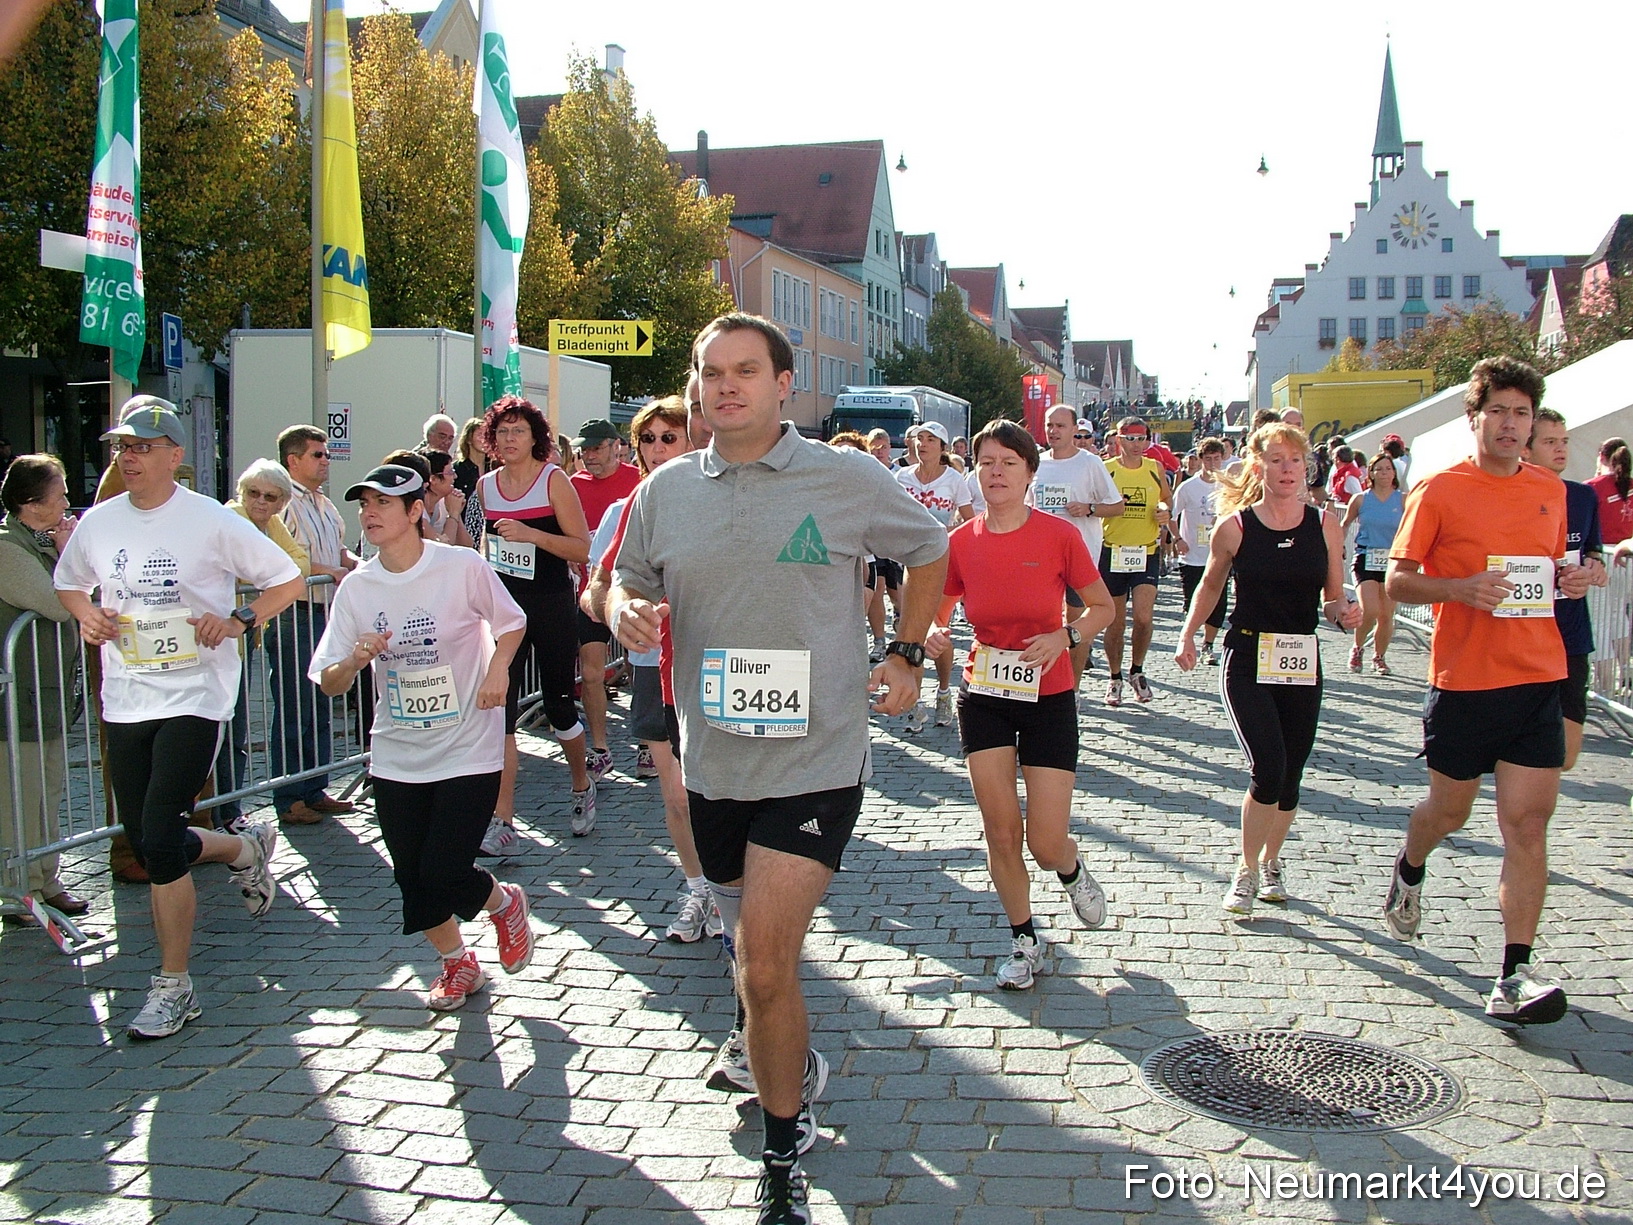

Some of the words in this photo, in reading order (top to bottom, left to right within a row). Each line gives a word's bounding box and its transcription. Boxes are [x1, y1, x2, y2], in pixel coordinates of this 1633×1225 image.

[557, 323, 625, 337] Treffpunkt
[167, 322, 178, 360] P
[557, 339, 629, 353] Bladenight
[1045, 496, 1068, 505] 2929
[501, 550, 531, 567] 3619
[1124, 557, 1141, 565] 560
[142, 569, 178, 577] 16.09.2007
[1506, 561, 1541, 573] Dietmar
[130, 590, 180, 599] Neumarkter
[1513, 583, 1543, 600] 839
[143, 596, 181, 606] Stadtlauf
[136, 619, 168, 631] Rainer
[154, 637, 178, 655] 25
[1276, 638, 1303, 649] Kerstin
[393, 649, 439, 661] Neumarkter
[406, 656, 439, 666] Stadtlauf
[730, 656, 771, 674] Oliver
[1279, 656, 1308, 670] 838
[991, 663, 1034, 683] 1168
[400, 675, 448, 689] Hannelore
[405, 693, 451, 713] 2027
[705, 681, 712, 694] C
[731, 688, 801, 713] 3484
[766, 724, 806, 732] PFLEIDERER
